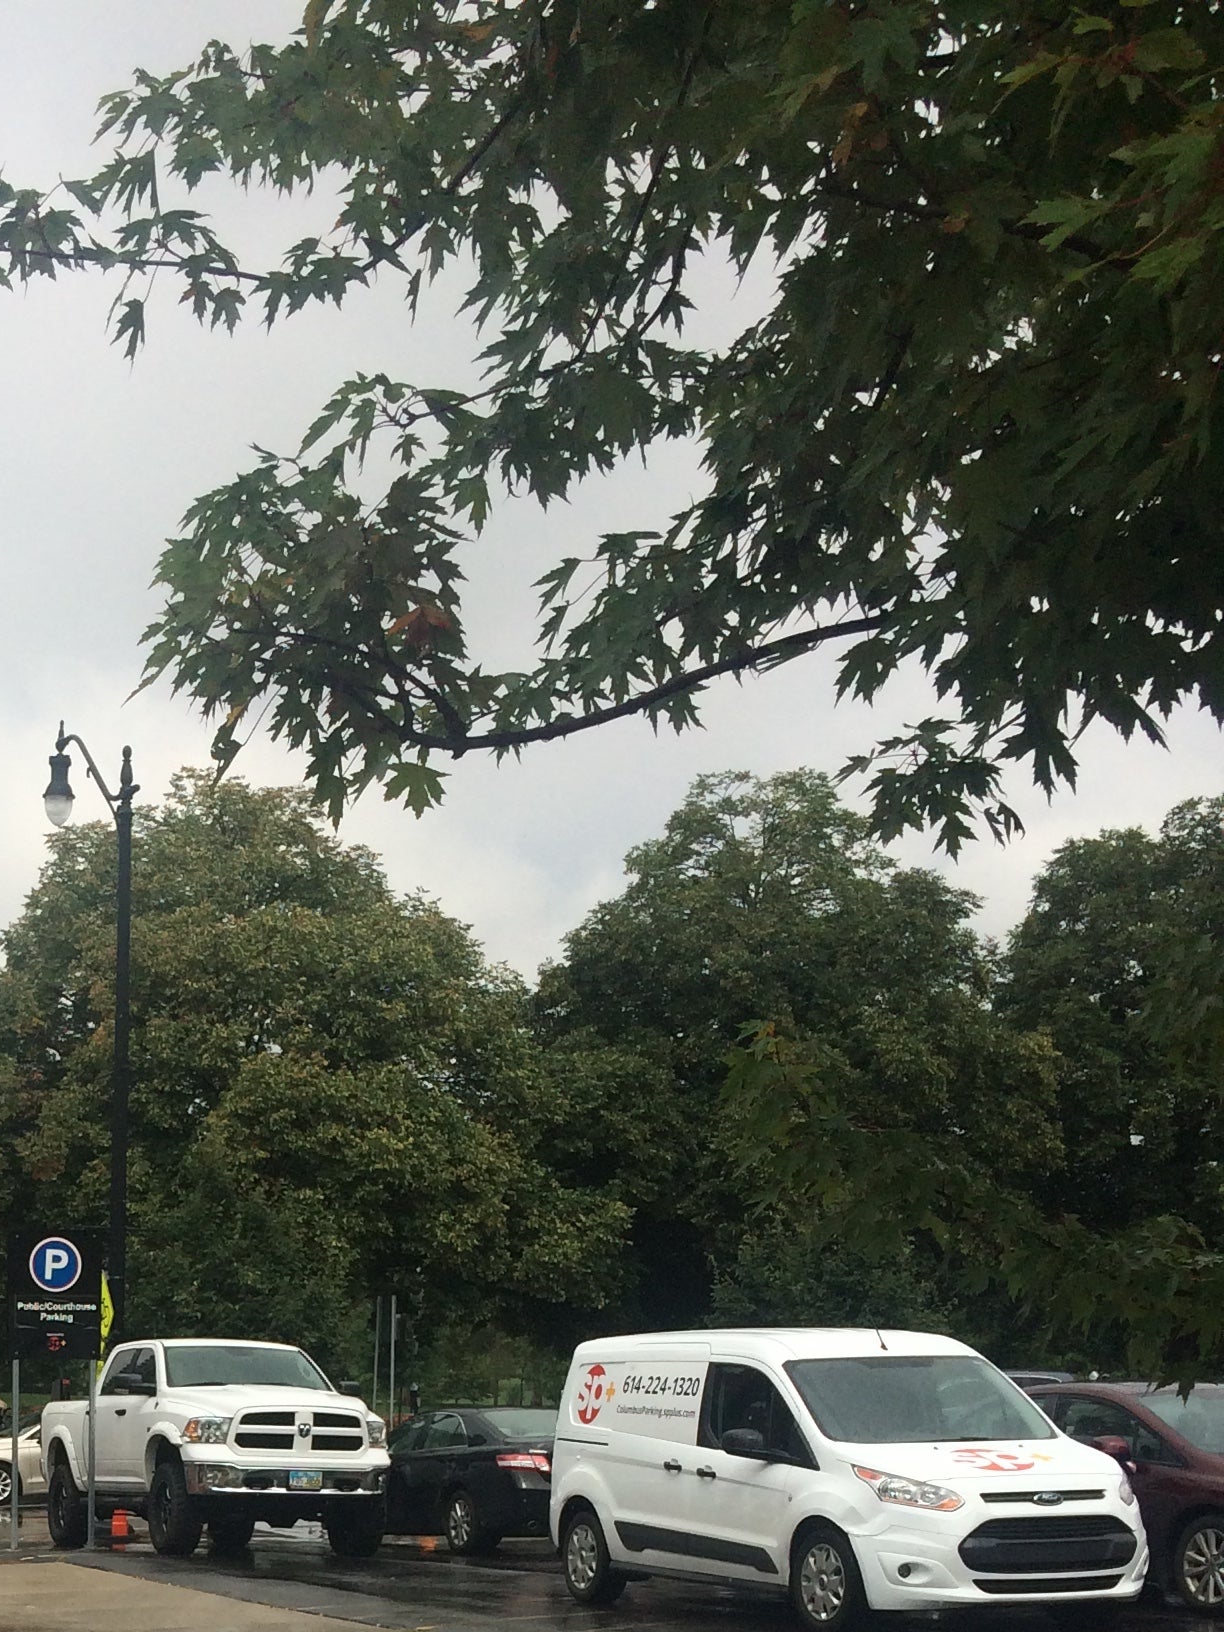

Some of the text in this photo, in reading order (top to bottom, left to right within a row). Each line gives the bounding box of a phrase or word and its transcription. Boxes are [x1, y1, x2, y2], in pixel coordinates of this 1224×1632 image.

[45, 1249, 69, 1280] P
[17, 1301, 97, 1312] Public/Courthouse
[40, 1312, 74, 1323] Parking
[622, 1375, 701, 1397] 614-224-1320
